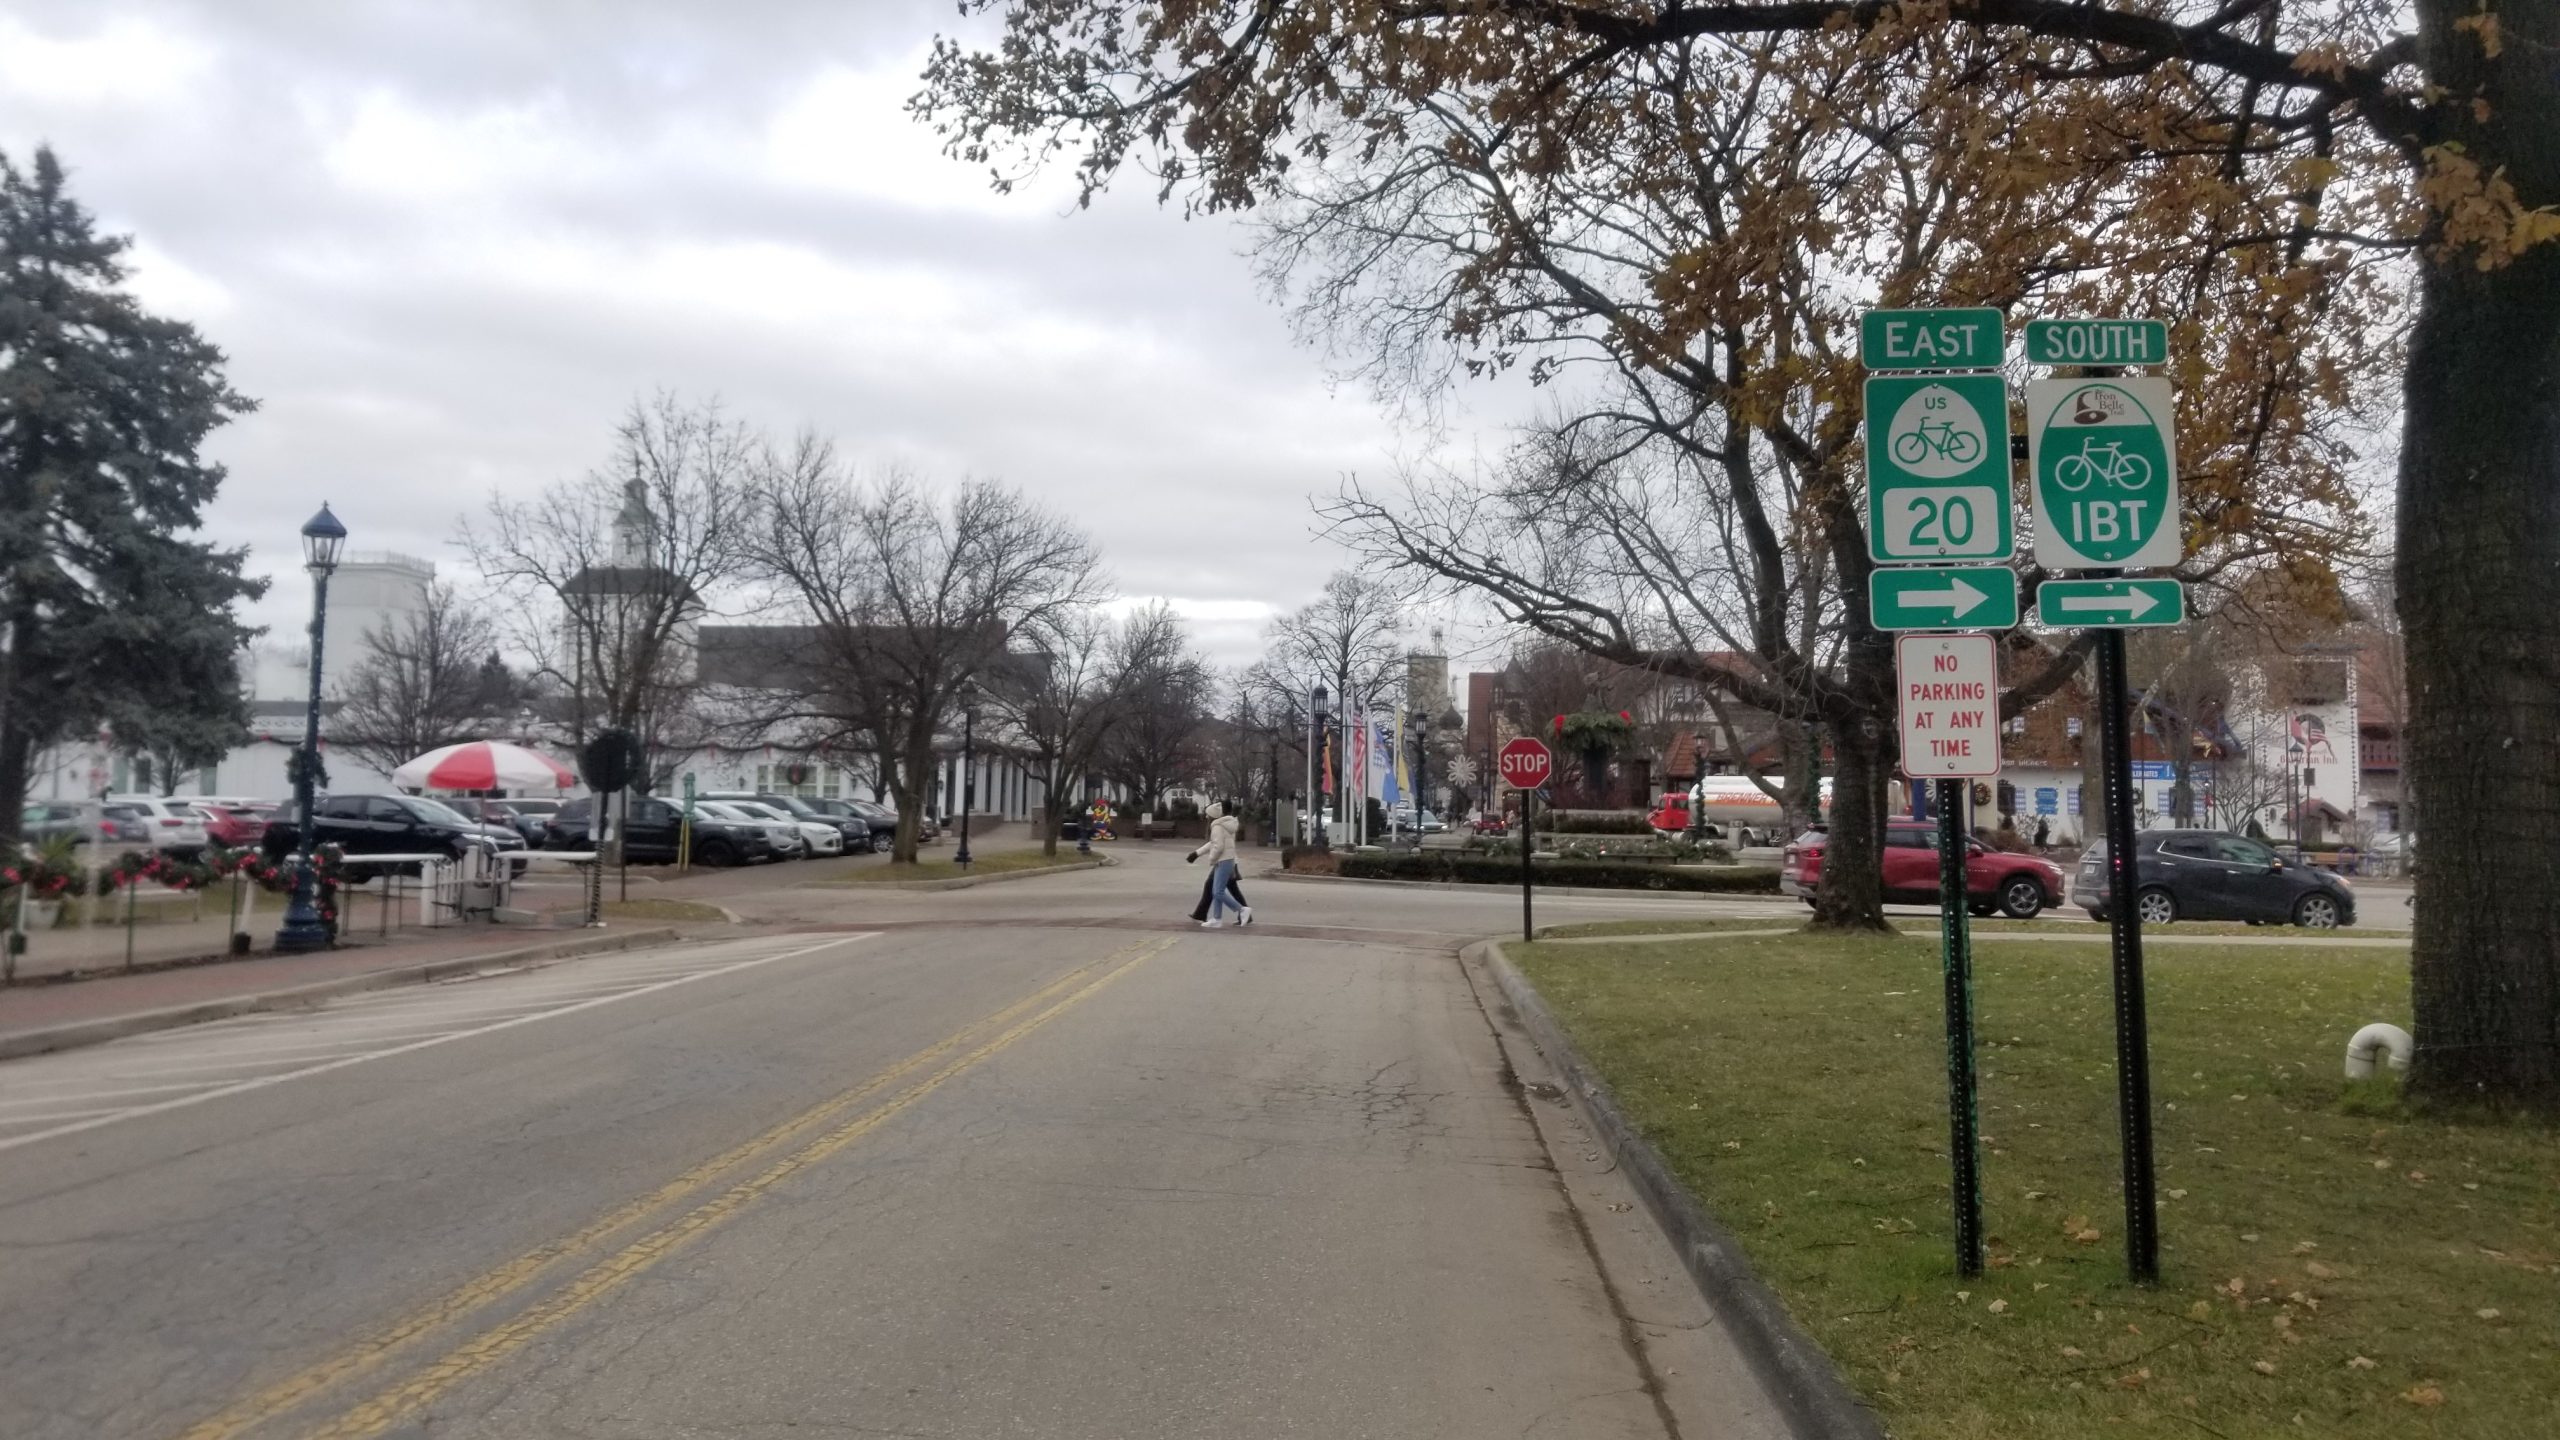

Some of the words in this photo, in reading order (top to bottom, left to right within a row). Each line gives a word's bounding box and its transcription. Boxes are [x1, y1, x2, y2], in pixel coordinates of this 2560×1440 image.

[1886, 321, 1979, 357] EAST
[2046, 325, 2147, 359] SOUTH
[1924, 397, 1947, 410] US
[2094, 390, 2116, 400] Iron
[2099, 400, 2124, 410] Belle
[1907, 495, 1973, 546] 20
[2072, 500, 2147, 542] IBT
[1934, 655, 1957, 672] NO
[1911, 683, 1985, 700] PARKING
[1915, 712, 1933, 729] AT
[1950, 710, 1984, 729] ANY
[1930, 740, 1972, 757] TIME
[1503, 753, 1547, 773] STOP
